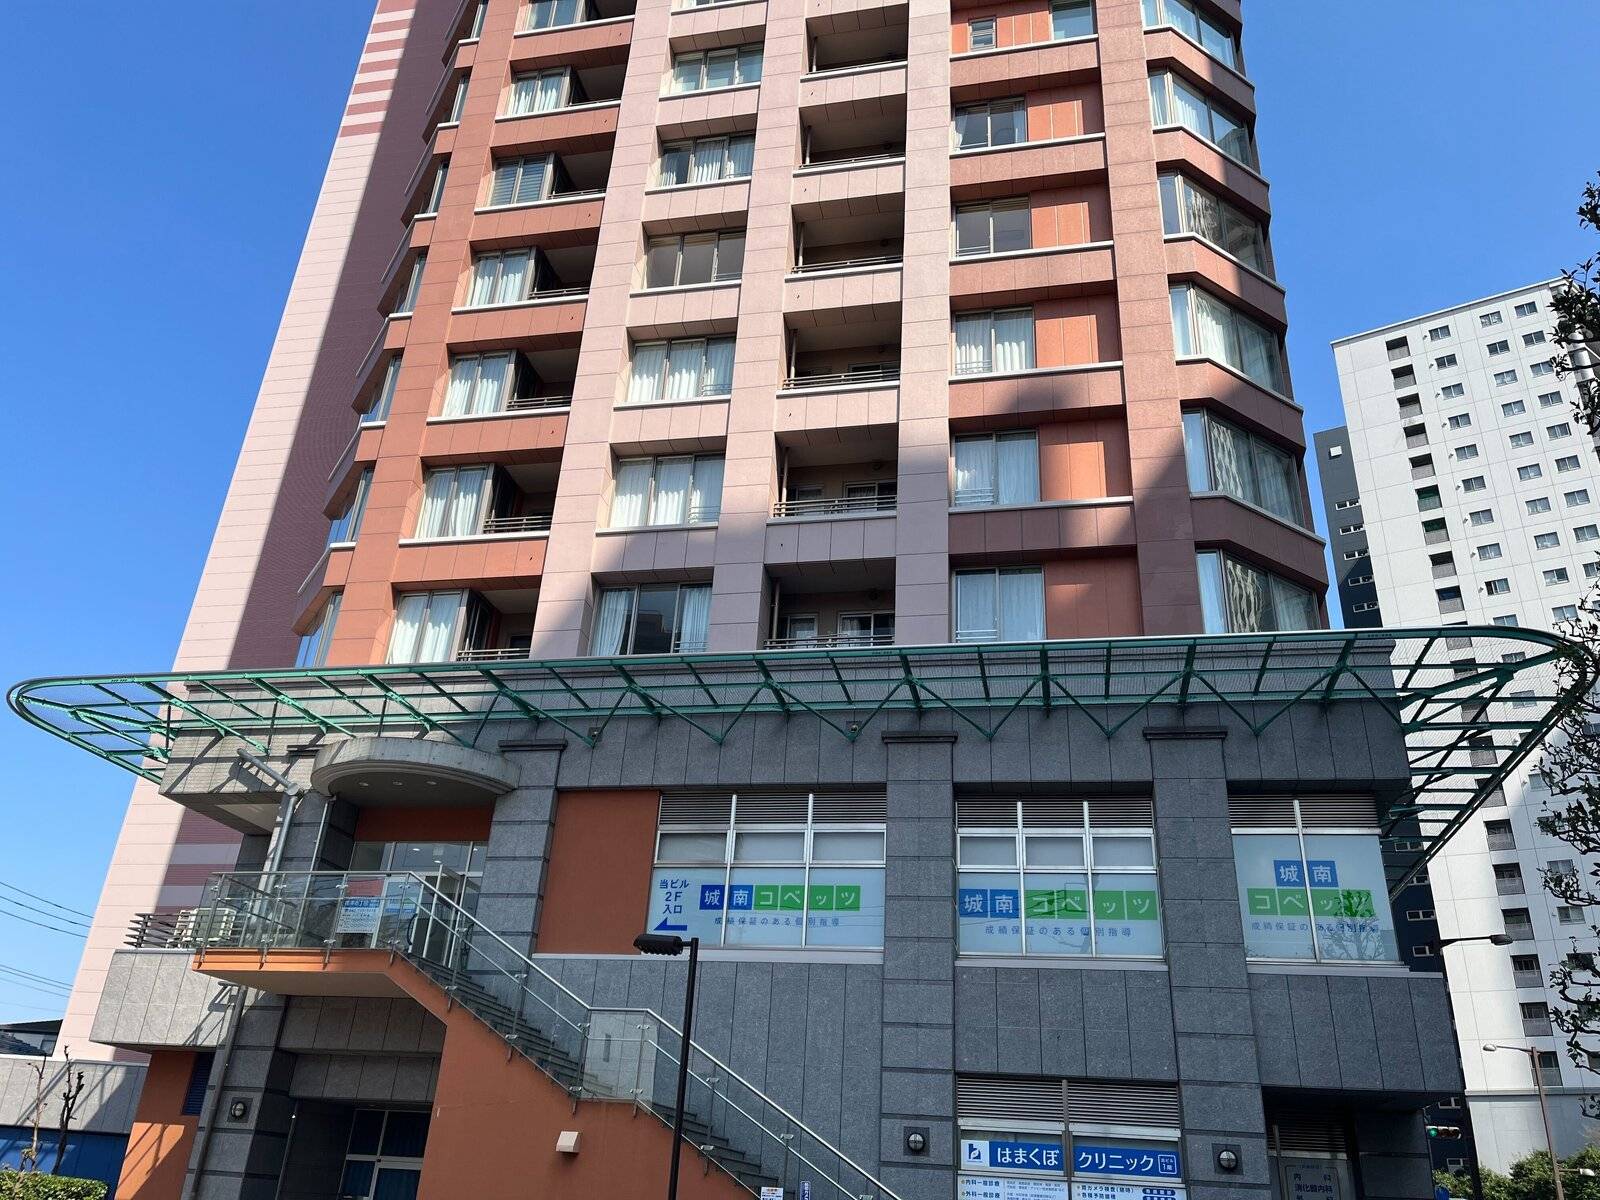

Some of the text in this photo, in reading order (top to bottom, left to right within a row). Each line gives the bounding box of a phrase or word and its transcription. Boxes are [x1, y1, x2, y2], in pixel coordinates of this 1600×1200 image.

[1279, 865, 1332, 882] 城南
[658, 878, 689, 889] 当ビル
[665, 891, 682, 902] 2F
[703, 888, 857, 907] 城南コベッツ
[963, 894, 1151, 915] 城南コベッツ
[662, 904, 682, 914] 入口
[997, 1147, 1154, 1172] はまくぼ クリニック
